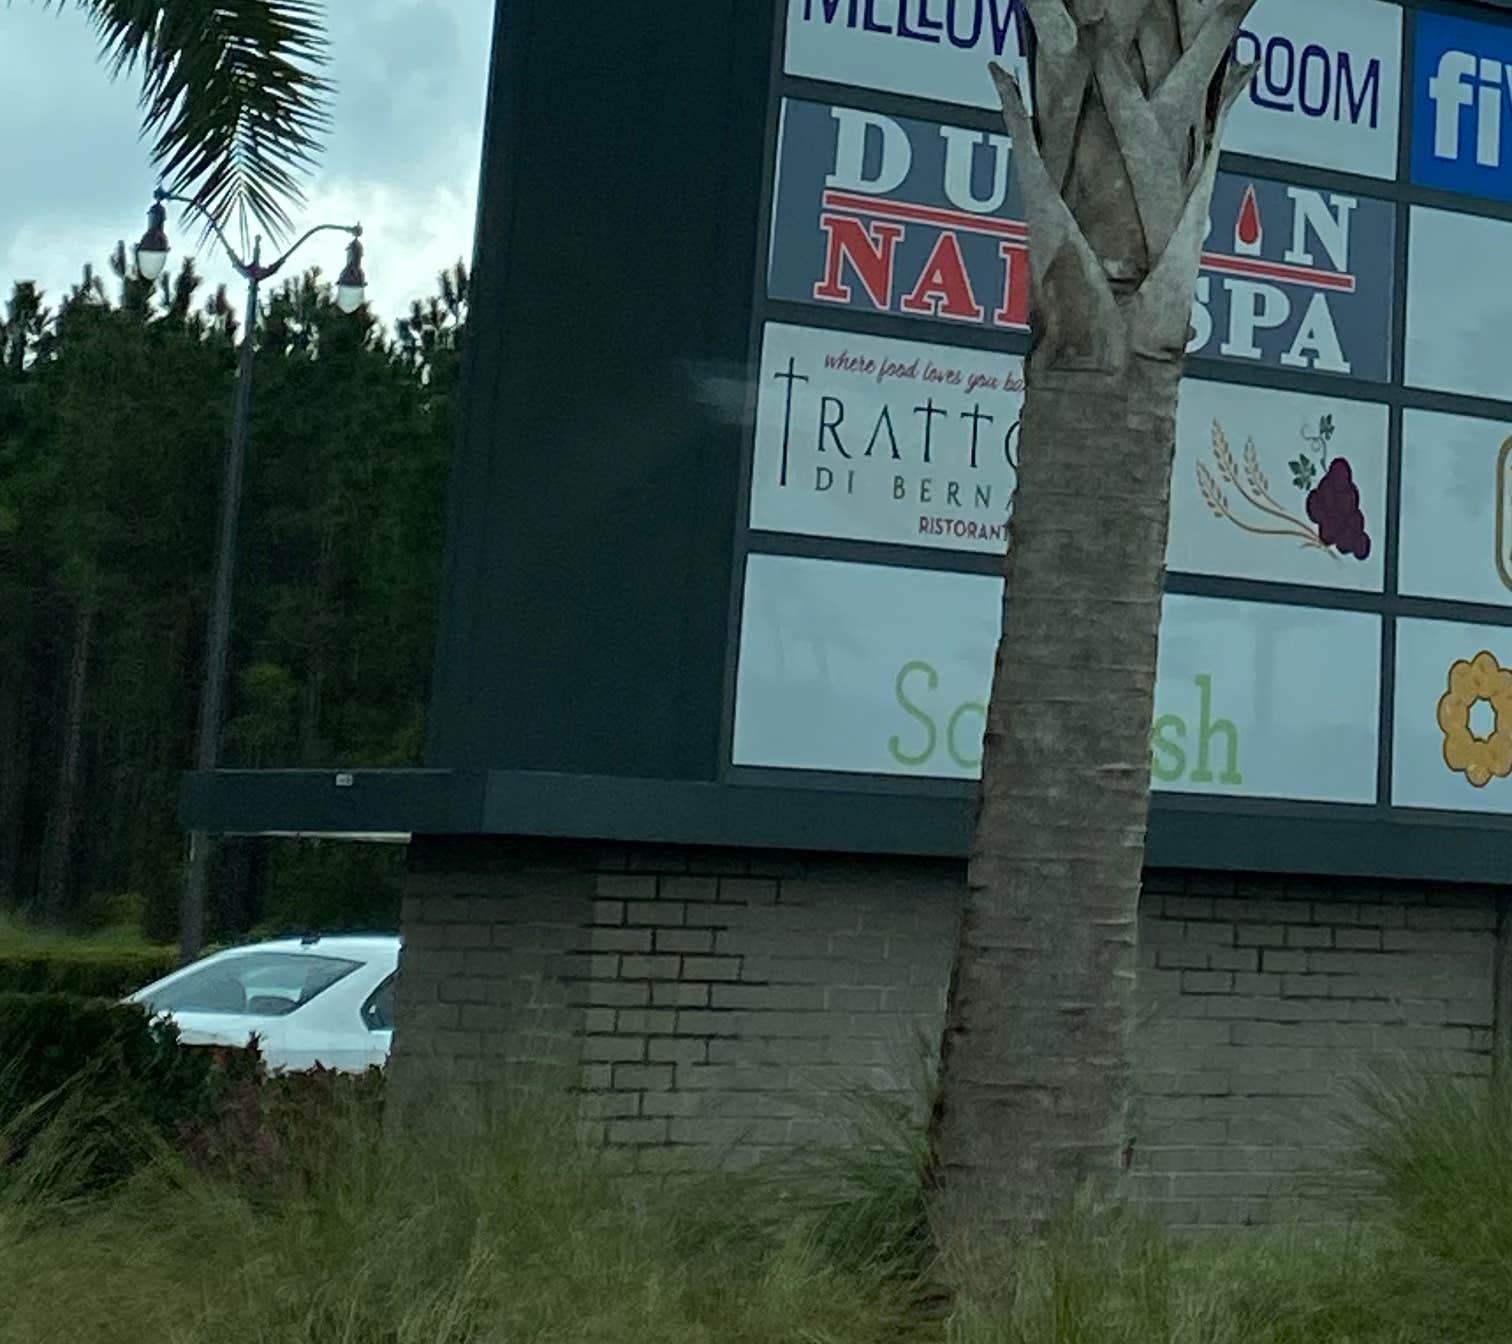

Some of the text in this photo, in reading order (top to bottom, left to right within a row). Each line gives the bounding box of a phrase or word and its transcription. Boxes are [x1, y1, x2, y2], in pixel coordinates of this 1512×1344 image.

[1230, 28, 1381, 129] ROOM
[813, 212, 1032, 334] NAI
[876, 357, 919, 384] food
[922, 360, 963, 385] loves
[963, 372, 998, 394] you
[774, 357, 1020, 487] TRATT
[815, 466, 1014, 511] DI BERN
[918, 515, 1009, 542] RISTORANT
